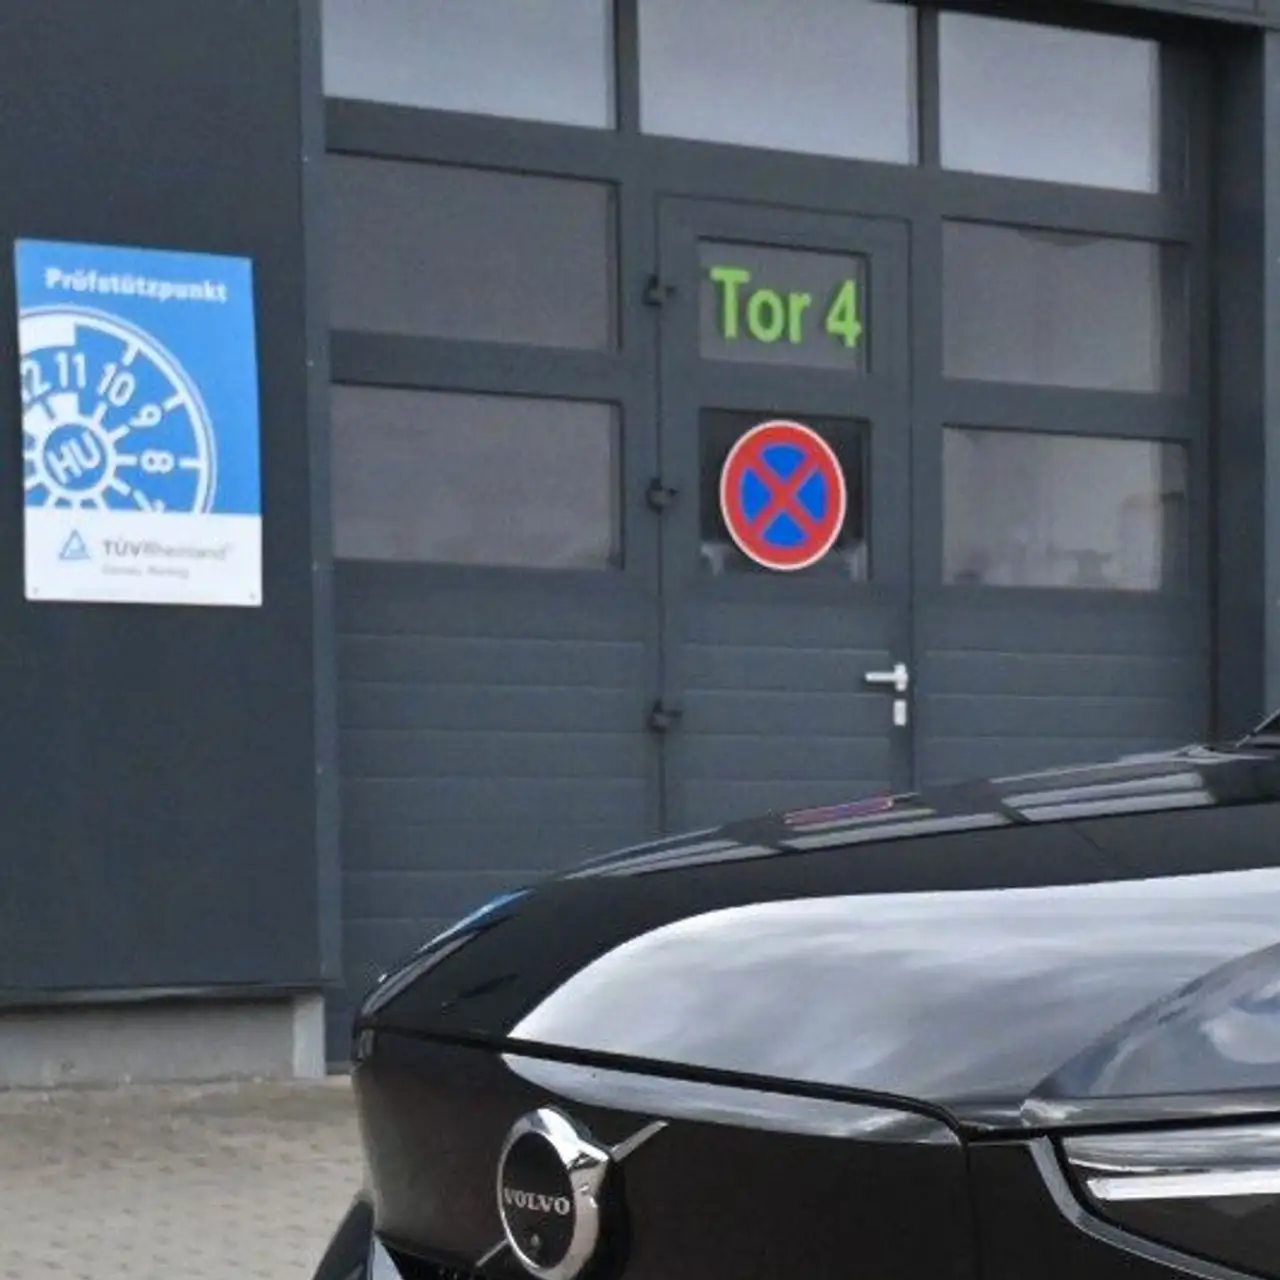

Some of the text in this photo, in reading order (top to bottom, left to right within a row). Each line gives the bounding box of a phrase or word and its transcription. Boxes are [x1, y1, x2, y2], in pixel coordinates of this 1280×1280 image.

[709, 265, 862, 348] Tor 4
[55, 351, 87, 389] 11
[97, 362, 136, 407] 10
[47, 430, 101, 485] HU
[140, 450, 175, 474] 8
[503, 1187, 571, 1216] VOLVO
